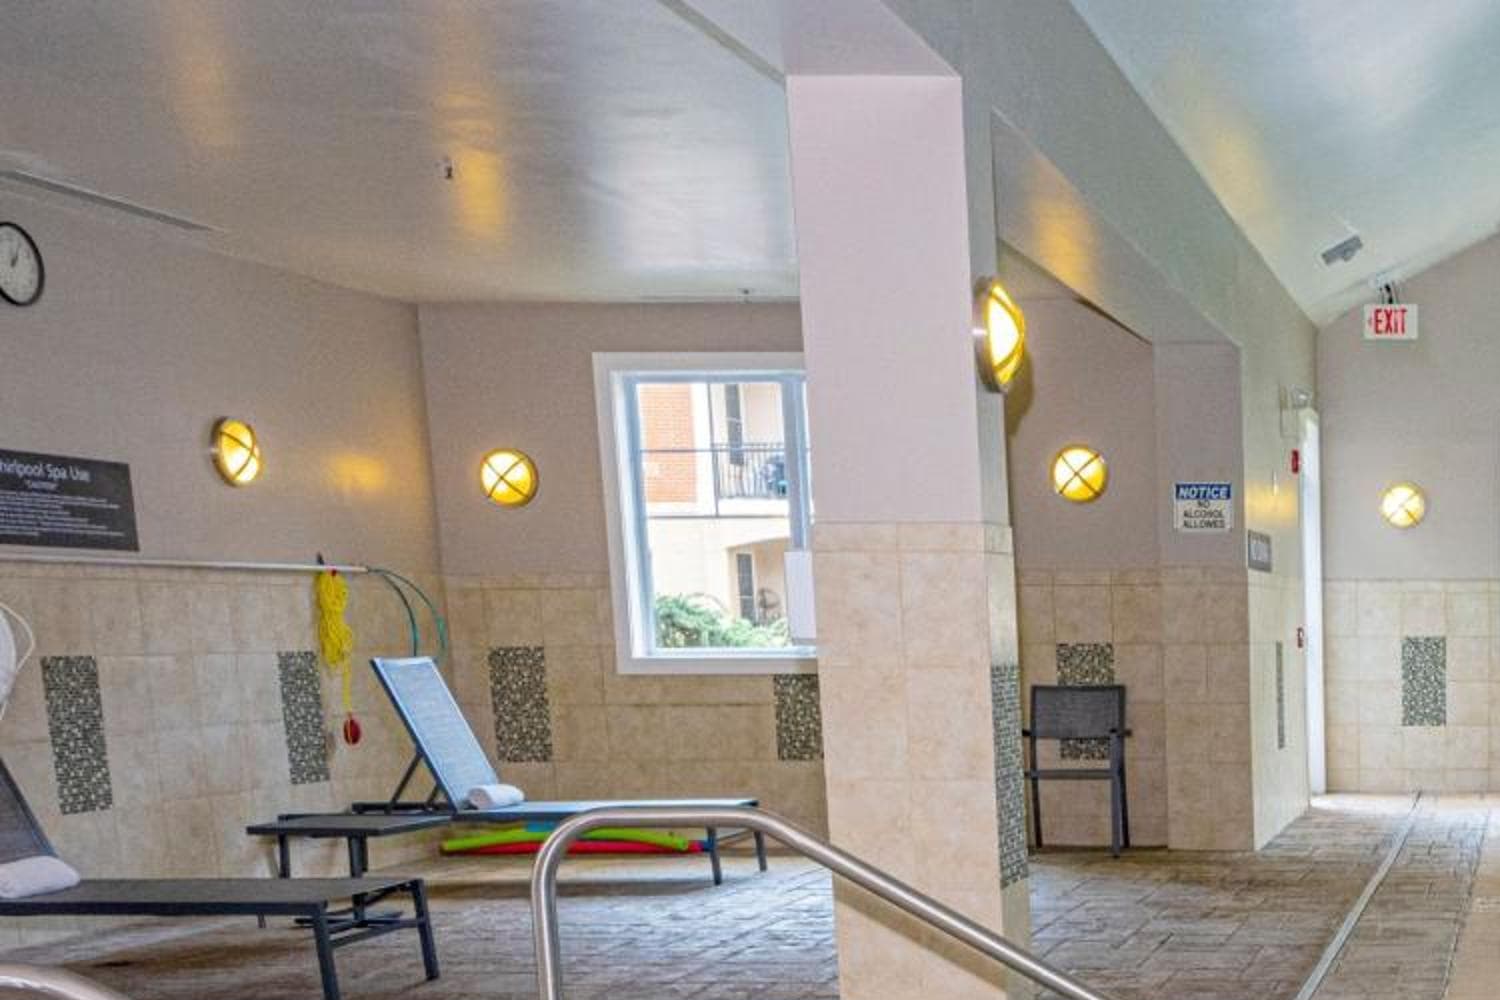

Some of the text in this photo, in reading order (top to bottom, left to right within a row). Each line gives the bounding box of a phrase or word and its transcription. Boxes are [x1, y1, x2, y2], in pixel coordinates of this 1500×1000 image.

[1374, 308, 1407, 334] EXIT
[0, 458, 42, 478] hirlpool
[46, 463, 67, 481] Spa
[1179, 486, 1228, 499] NOTICE
[1197, 500, 1211, 509] NO
